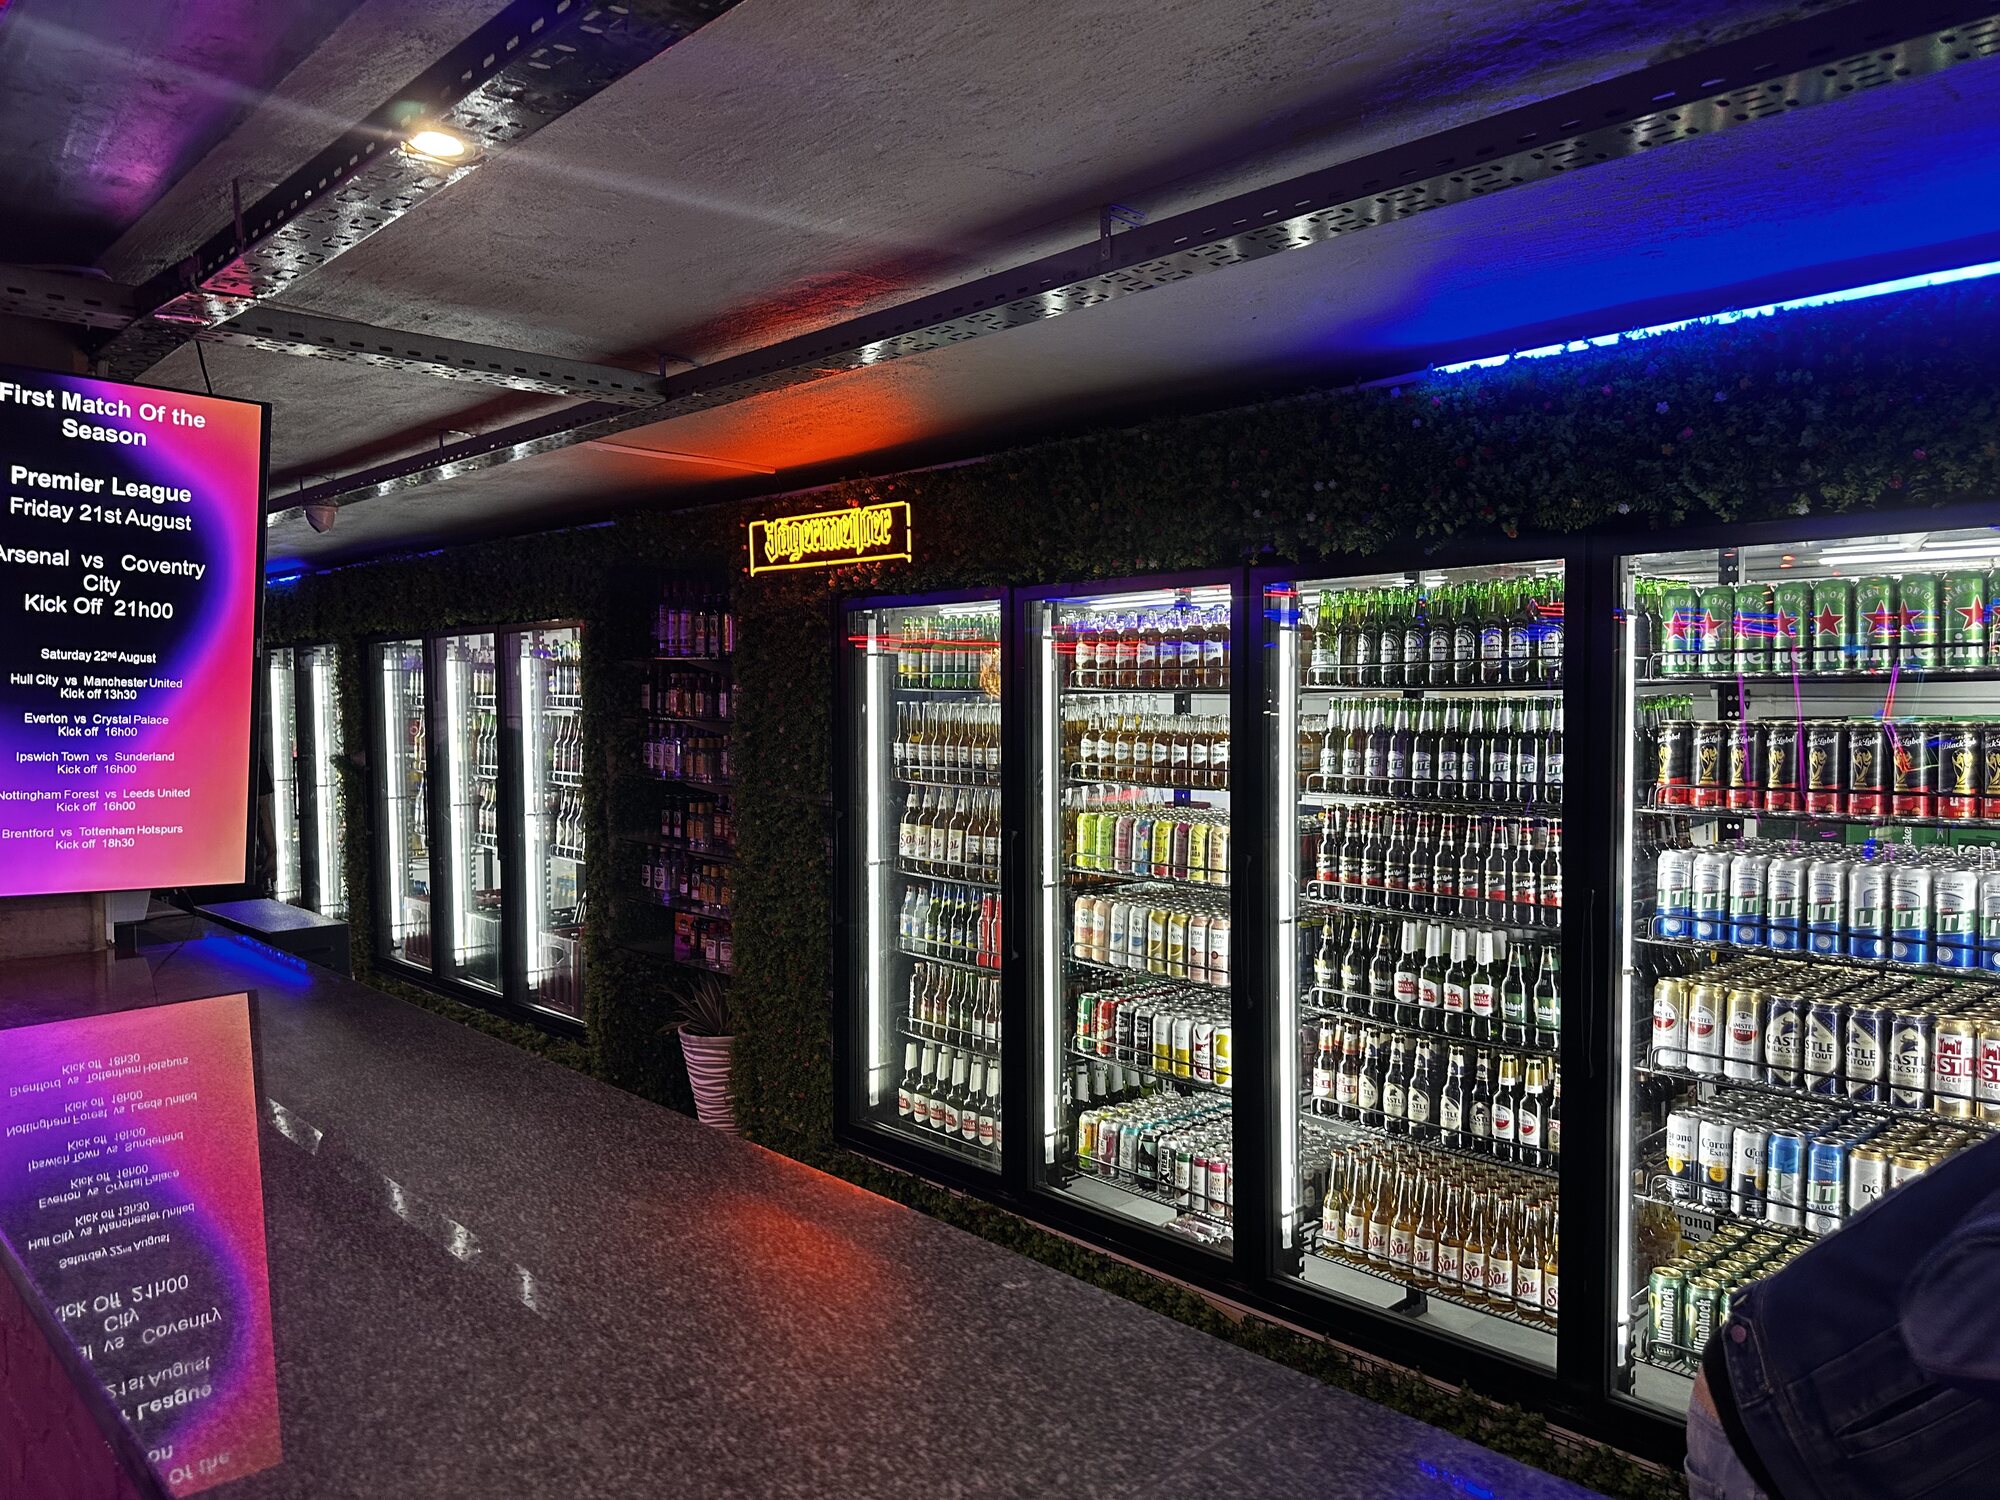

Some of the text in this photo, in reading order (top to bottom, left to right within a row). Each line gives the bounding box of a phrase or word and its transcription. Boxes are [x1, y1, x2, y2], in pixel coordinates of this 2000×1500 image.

[0, 382, 206, 428] First Match Of the
[62, 419, 146, 446] Season
[11, 465, 191, 504] Premier League
[11, 497, 191, 531] Friday 21st August
[0, 544, 205, 580] Arsenal vs Coventry
[84, 574, 120, 596] City
[25, 594, 173, 619] Kick Off 21h00
[41, 648, 91, 663] Saturday
[119, 652, 156, 664] August
[11, 673, 182, 688] Hull City vs Manchester United
[61, 688, 137, 699] Kick off 13h30
[25, 713, 67, 724] Everton
[93, 714, 131, 726] Crystal
[134, 715, 168, 725] Palace
[58, 727, 137, 737] Kick off 16h00
[16, 752, 58, 764] Ipswich
[62, 752, 89, 761] Town
[114, 752, 174, 761] Sunderland
[57, 764, 136, 774] Kick off 16h00
[1547, 764, 1562, 775] LIT
[0, 790, 61, 801] Nottingham
[64, 790, 99, 799] Forest
[123, 789, 155, 798] Leeds
[158, 788, 190, 798] United
[56, 802, 136, 812] Kick off 16h00
[2, 825, 183, 839] Brentford vs Tottenham Hotspurs
[56, 839, 135, 849] Kick off 18h30
[1767, 1034, 1800, 1047] CAST
[1806, 1040, 1834, 1054] STLE
[1391, 1240, 1410, 1257] SOL
[1488, 1267, 1508, 1287] SOL
[1658, 1288, 1674, 1343] Windhoek
[1694, 1298, 1711, 1352] Windhoek
